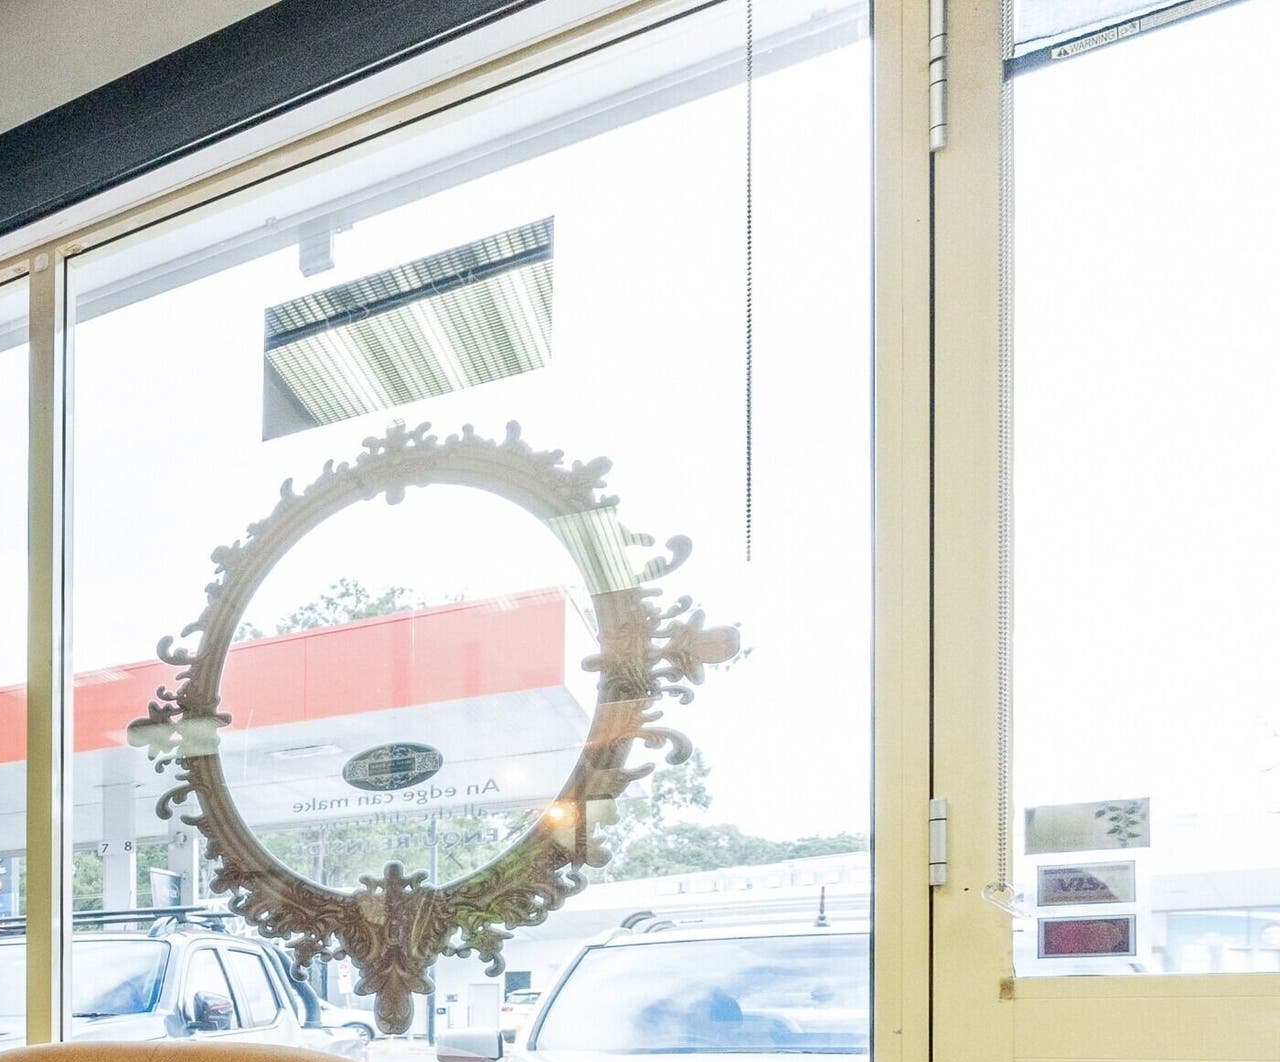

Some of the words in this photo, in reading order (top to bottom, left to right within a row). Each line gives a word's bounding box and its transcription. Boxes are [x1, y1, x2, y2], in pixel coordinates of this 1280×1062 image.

[1069, 31, 1116, 53] WARNING
[101, 843, 109, 853] 7
[124, 841, 132, 851] 8
